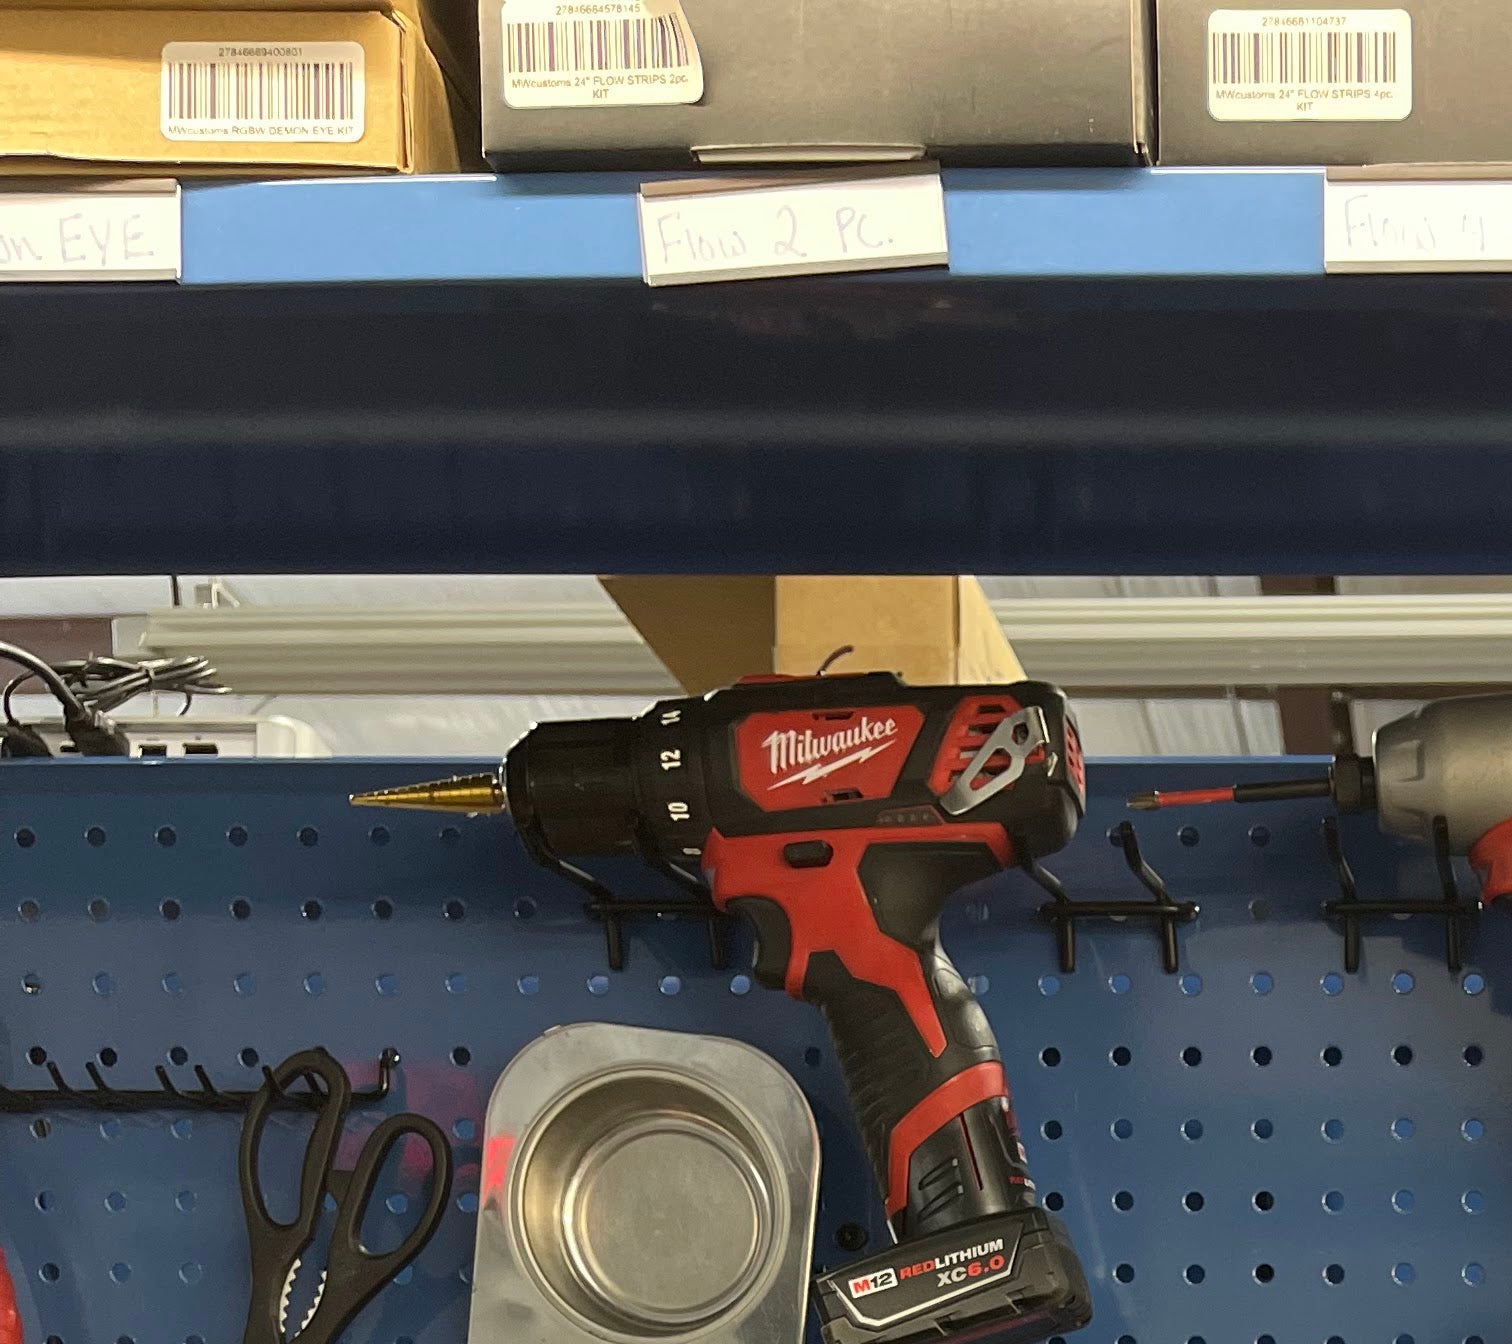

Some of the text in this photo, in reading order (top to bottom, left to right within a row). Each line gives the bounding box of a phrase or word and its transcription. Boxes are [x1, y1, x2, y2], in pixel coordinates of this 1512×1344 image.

[593, 75, 625, 86] FLOW
[627, 74, 667, 85] STRIPS
[592, 89, 609, 99] KIT
[1297, 90, 1329, 99] FLOW
[1332, 89, 1371, 99] STRIPS
[1296, 102, 1313, 111] KIT
[231, 126, 265, 135] RGBW
[269, 126, 309, 135] DEMON
[312, 126, 334, 135] EYE
[337, 126, 354, 135] KIT
[59, 213, 154, 266] EYE
[656, 211, 748, 264] Flow
[774, 204, 808, 258] 2
[761, 716, 899, 775] Milwaukee
[660, 749, 682, 771] 12
[852, 1238, 1004, 1295] M12 REDLITHIUM
[936, 1254, 1006, 1288] XC6.0
